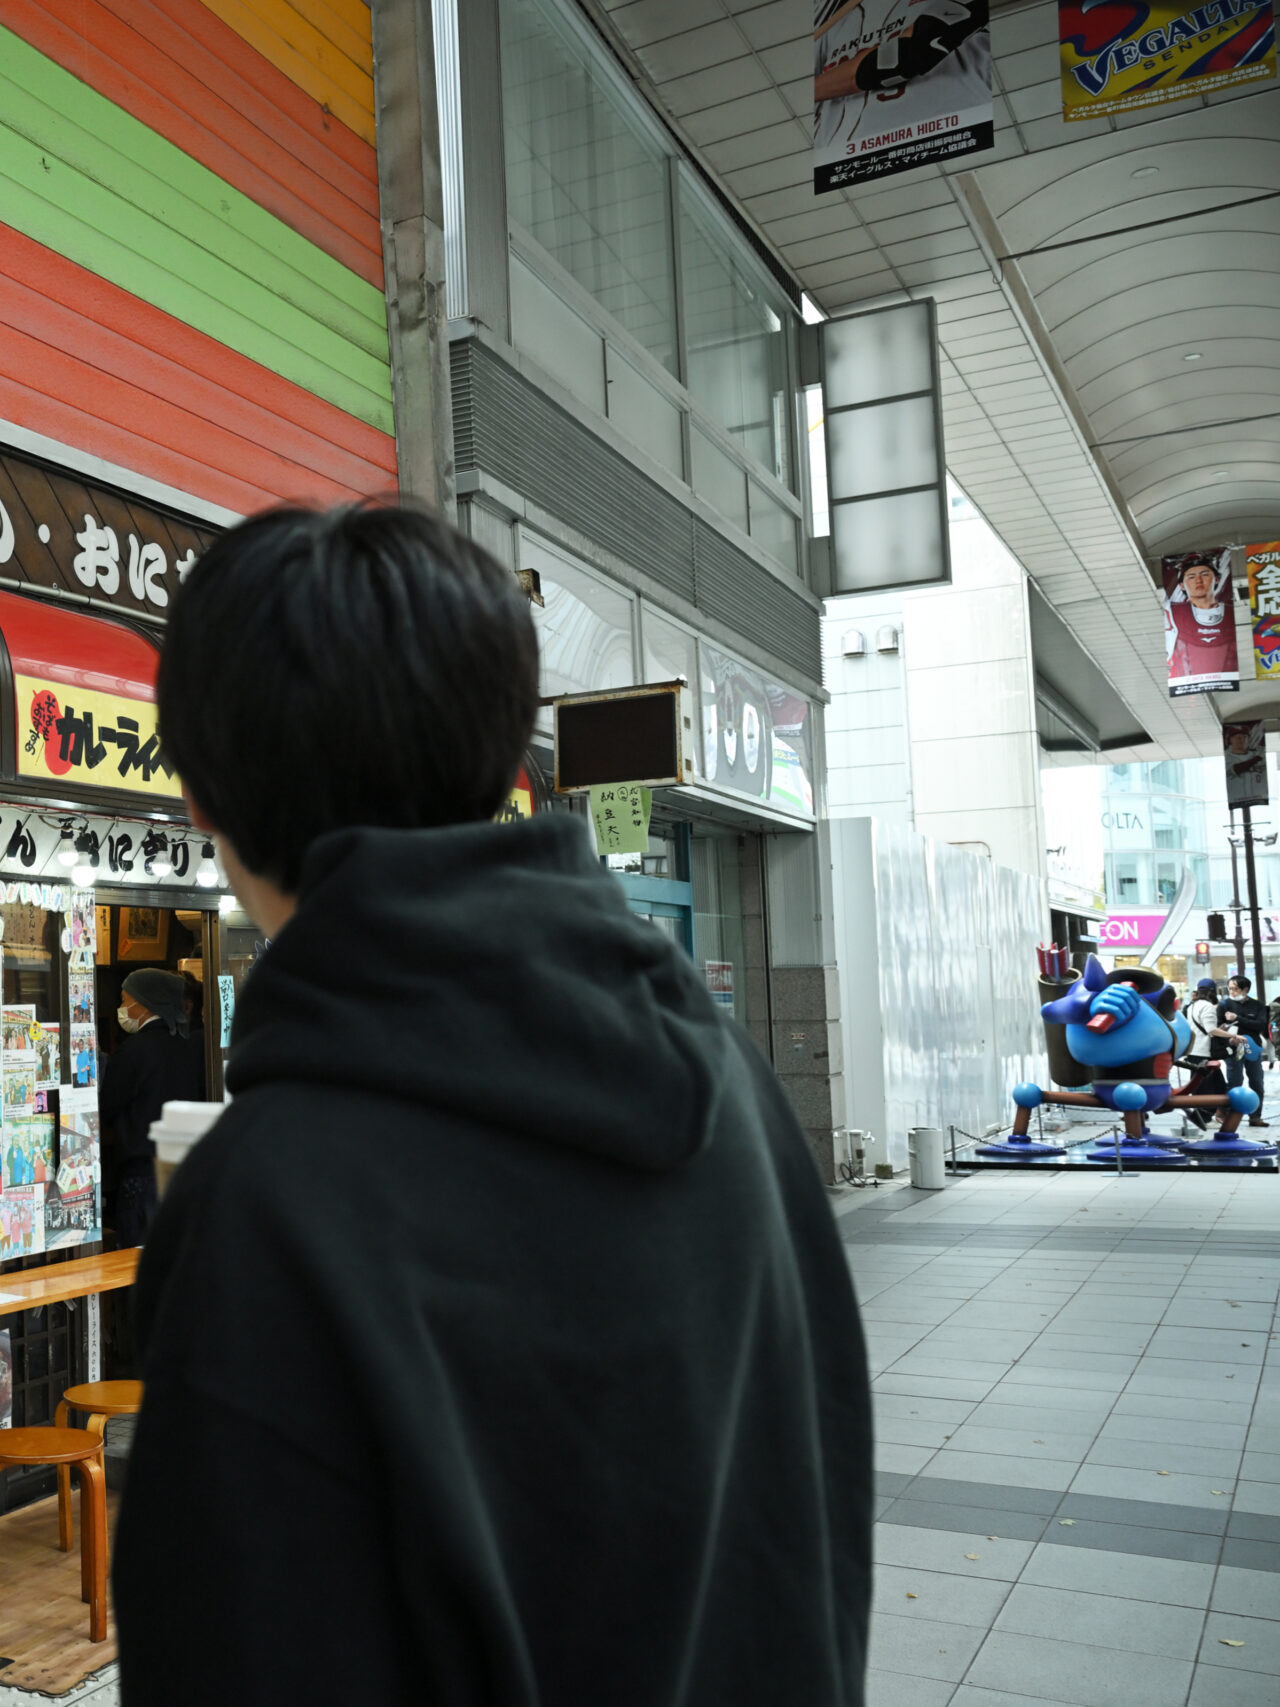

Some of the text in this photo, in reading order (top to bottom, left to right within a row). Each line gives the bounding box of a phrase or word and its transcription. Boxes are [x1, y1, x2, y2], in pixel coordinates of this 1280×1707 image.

[831, 16, 906, 60] RAKUTEN
[1143, 19, 1240, 71] SENDAI
[846, 115, 959, 155] 3 ASAMURA HIDETO
